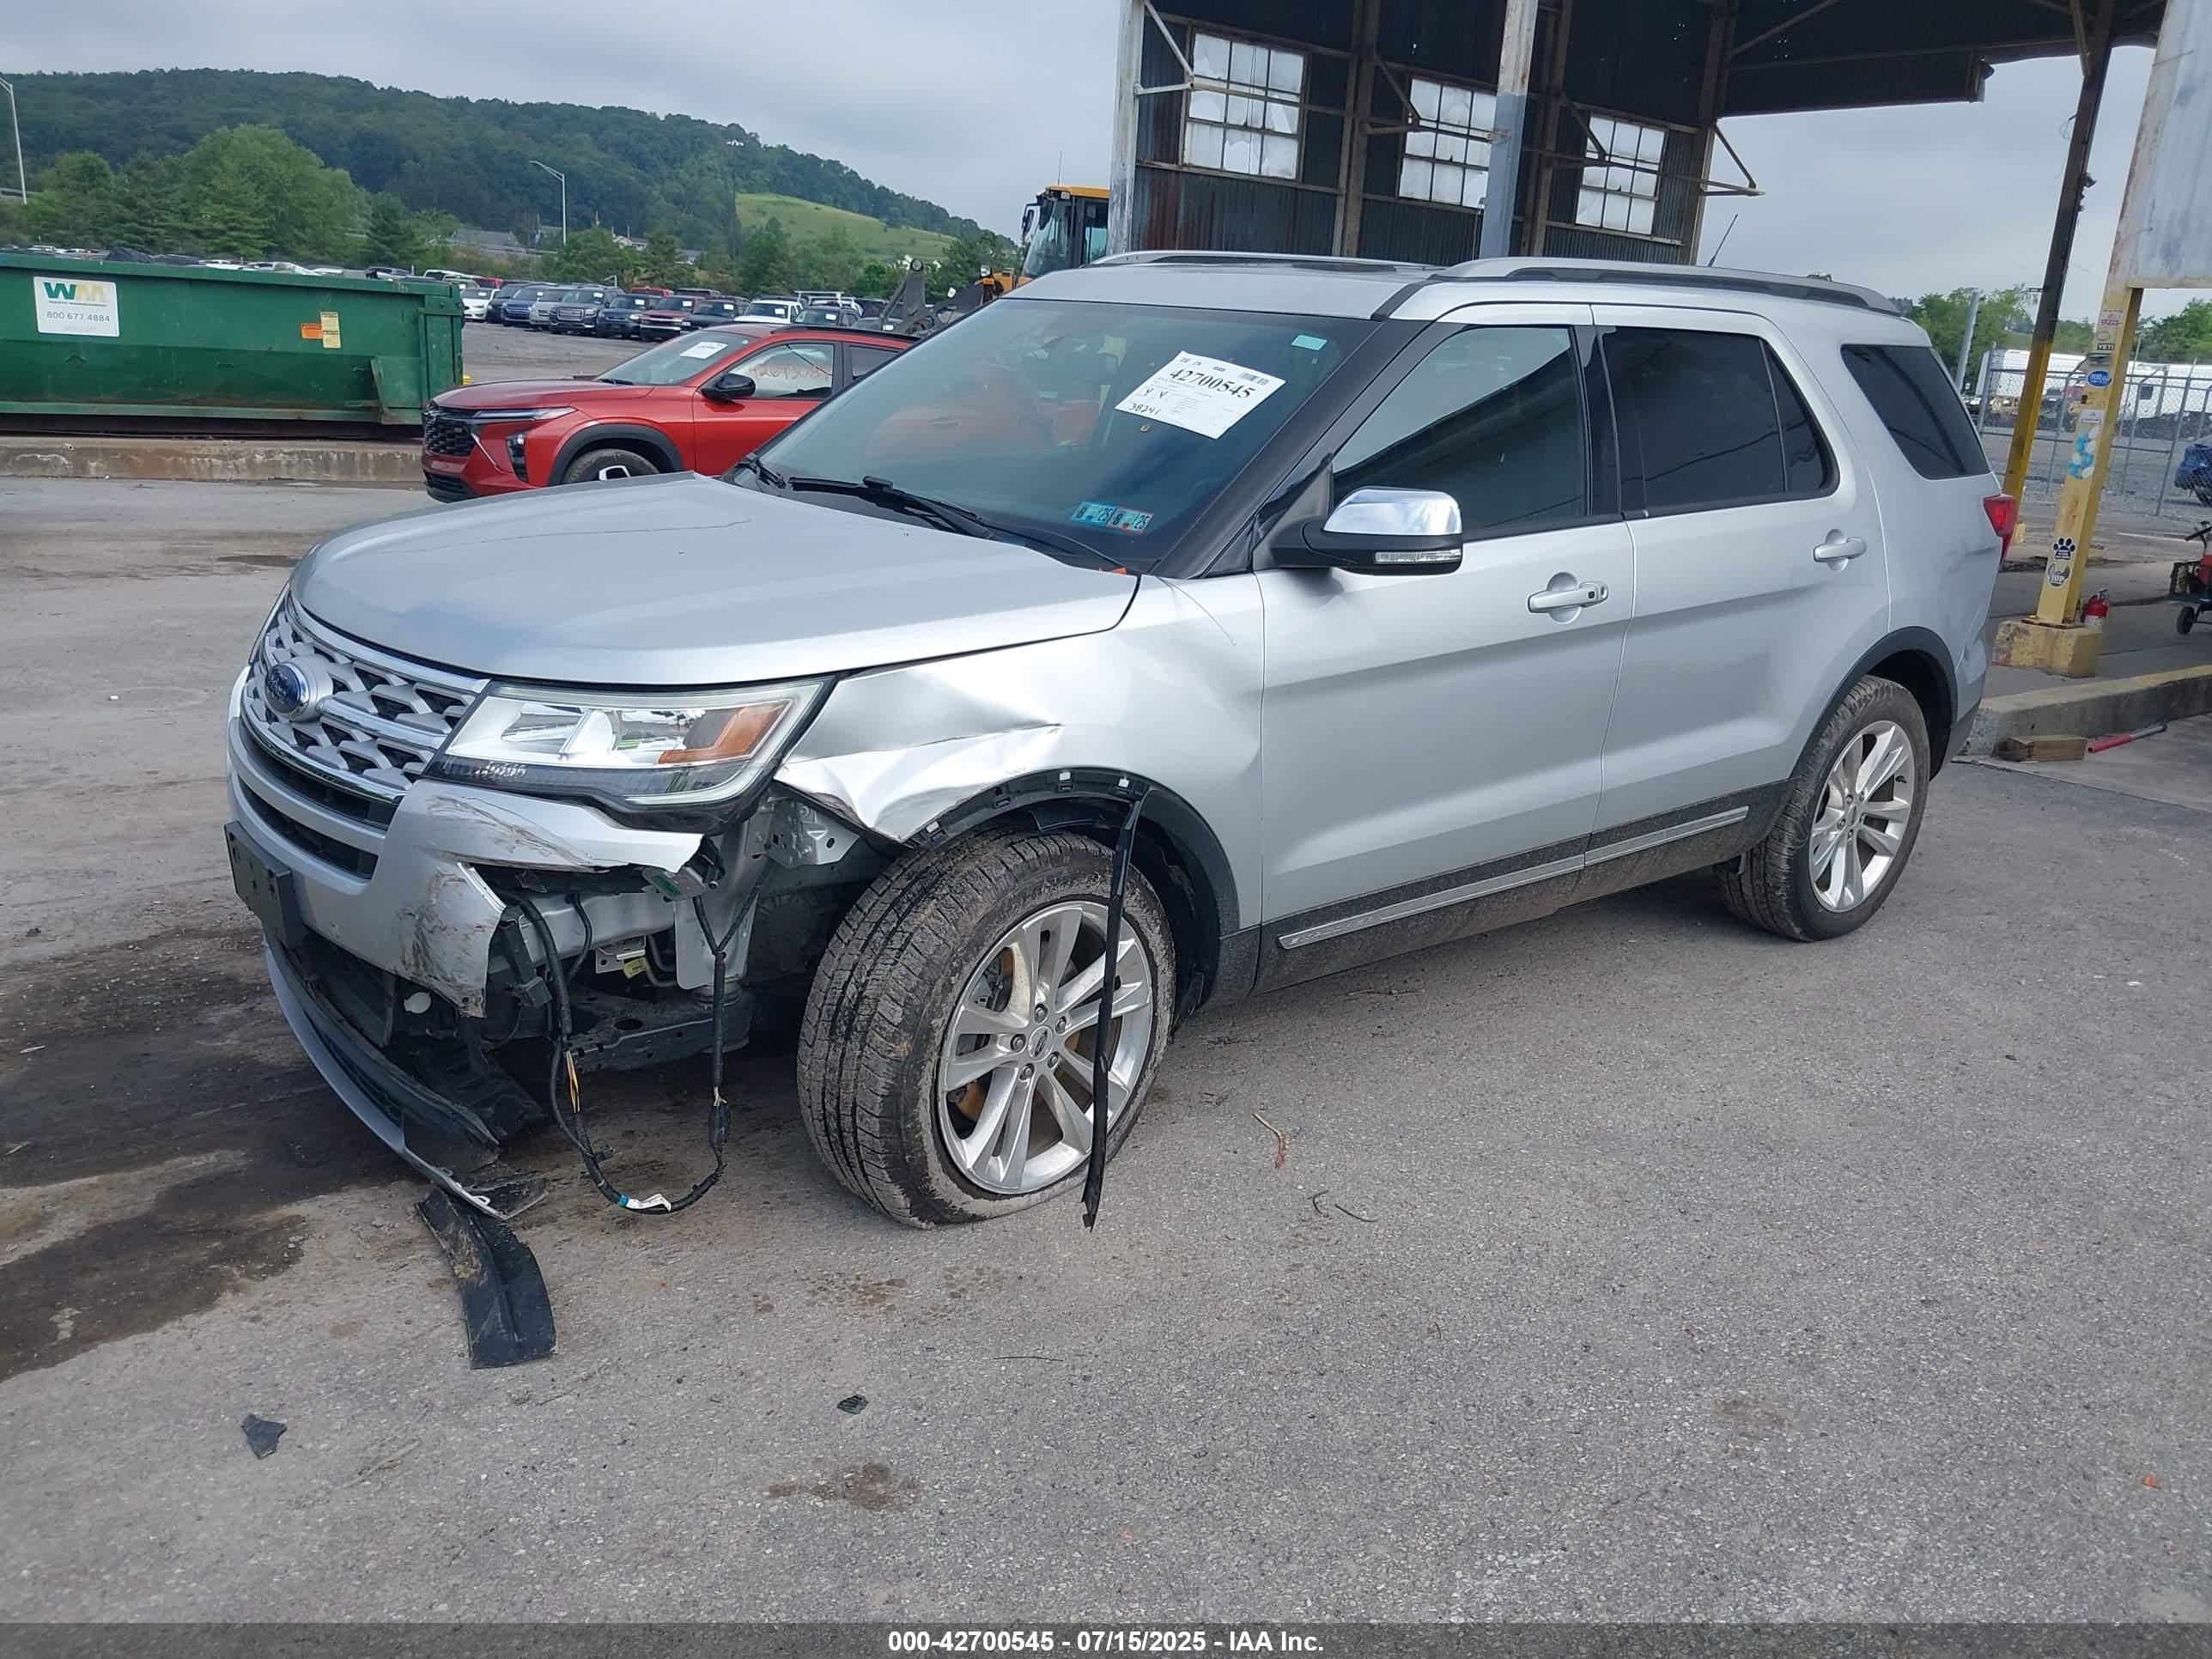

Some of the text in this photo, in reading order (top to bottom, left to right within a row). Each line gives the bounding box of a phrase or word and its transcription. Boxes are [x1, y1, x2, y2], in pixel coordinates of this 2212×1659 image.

[43, 282, 105, 302] WM
[46, 311, 64, 319] 800
[1169, 368, 1256, 399] 42700545
[1129, 403, 1162, 416] 38241
